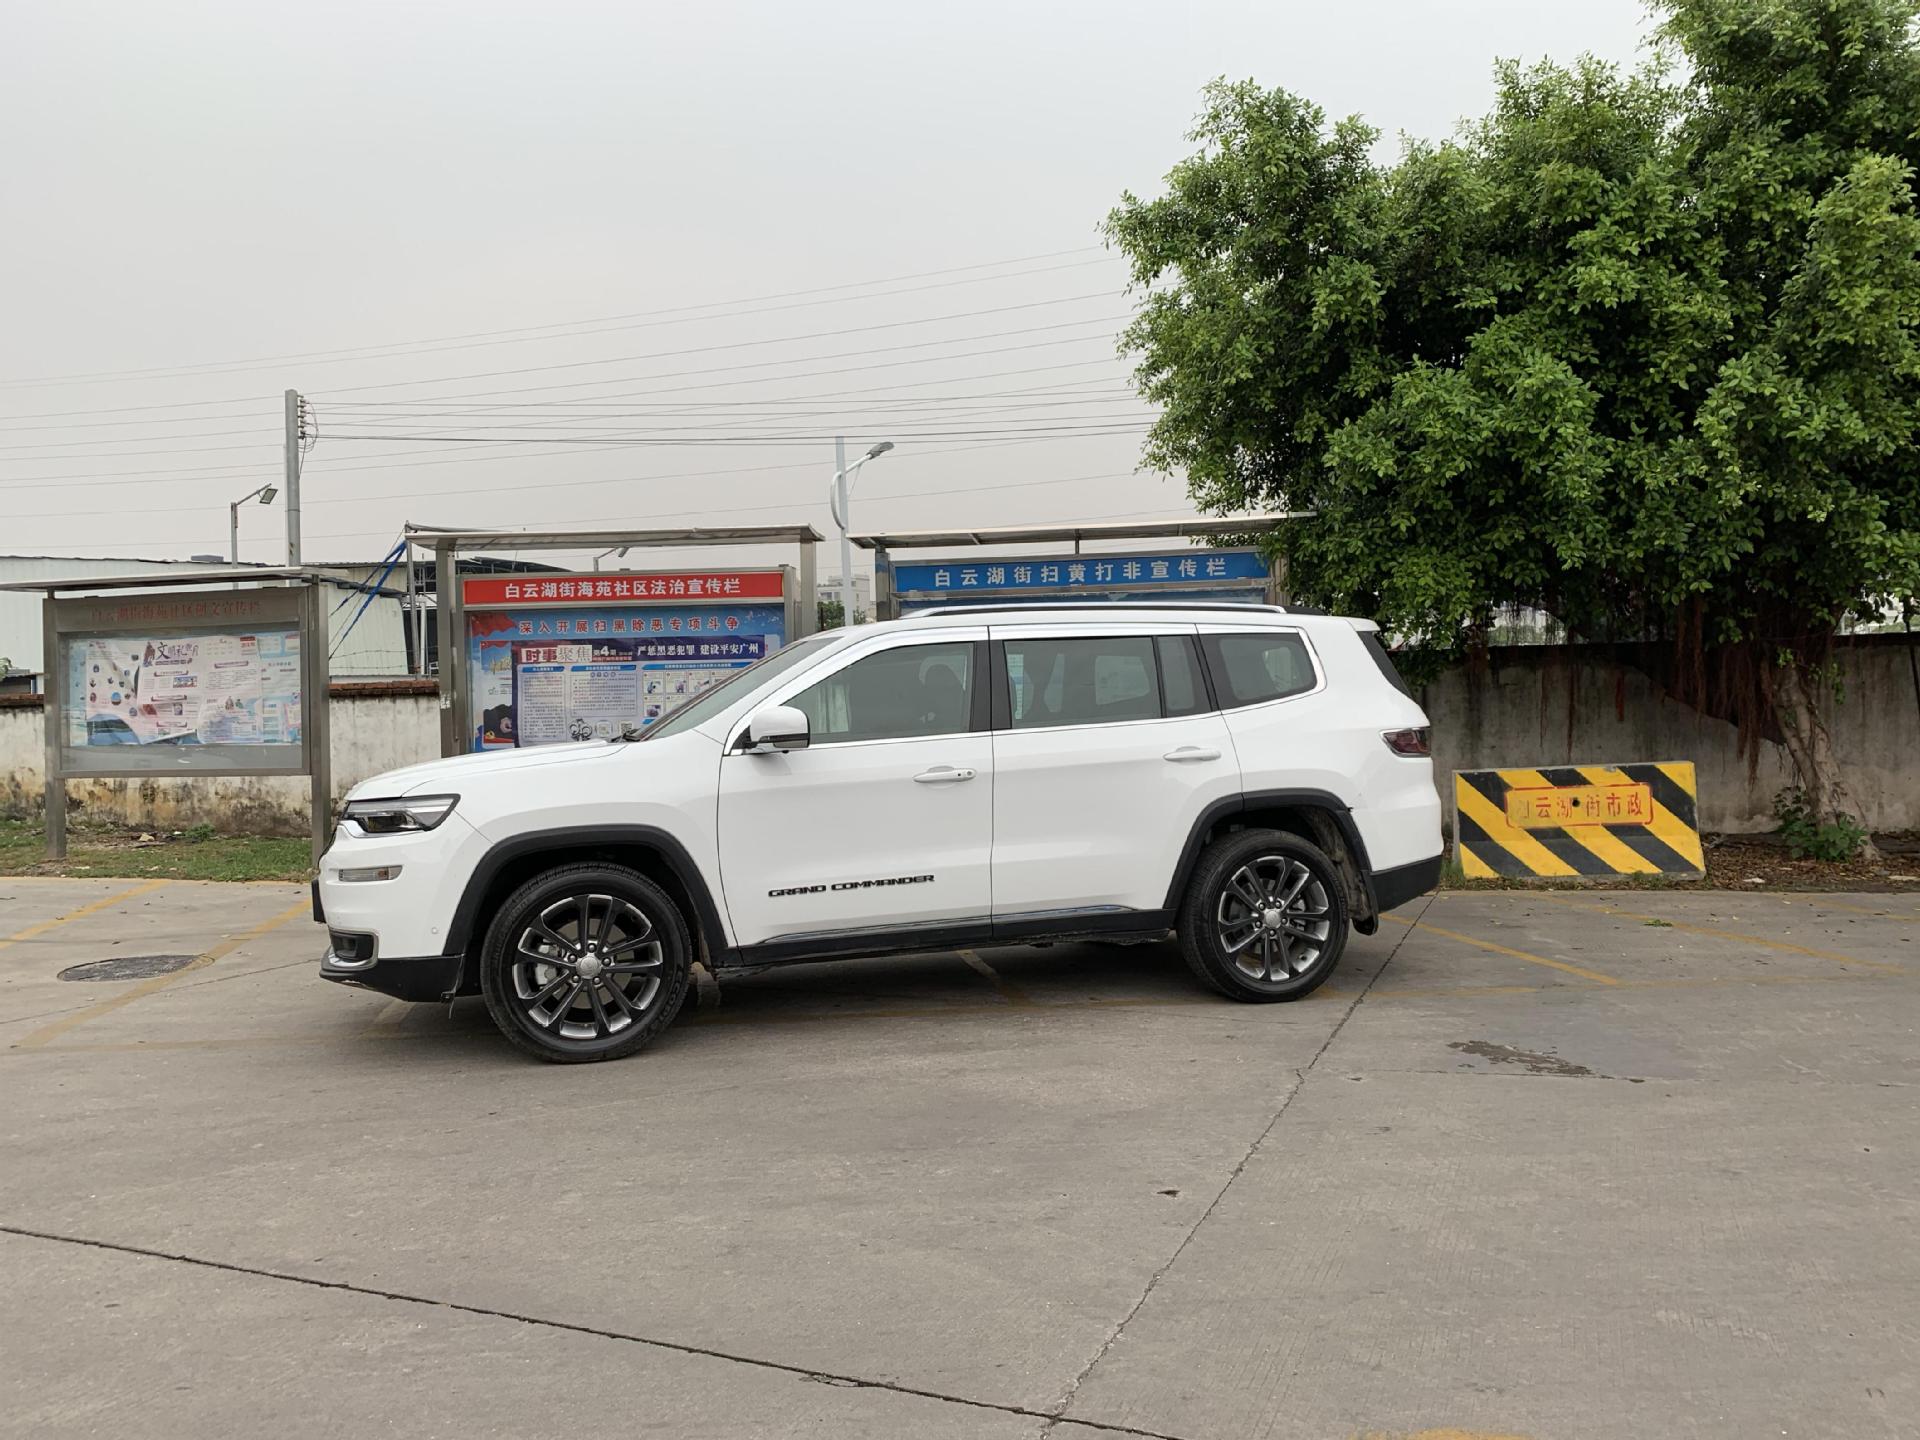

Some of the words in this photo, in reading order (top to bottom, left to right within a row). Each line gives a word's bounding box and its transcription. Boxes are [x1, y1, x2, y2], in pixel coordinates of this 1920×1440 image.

[935, 558, 1226, 587] 白云湖街扫黄打非宣传栏
[505, 579, 741, 598] 白云湖街海苑社区法治宣传栏
[519, 616, 740, 634] 深入开展扫黑除恶专项斗争
[526, 646, 591, 662] 时事聚焦
[637, 645, 695, 656] 严惩黑恶犯罪
[700, 643, 759, 655] 建设平安广州
[768, 884, 827, 897] GRAND
[831, 874, 935, 891] COMMANDER
